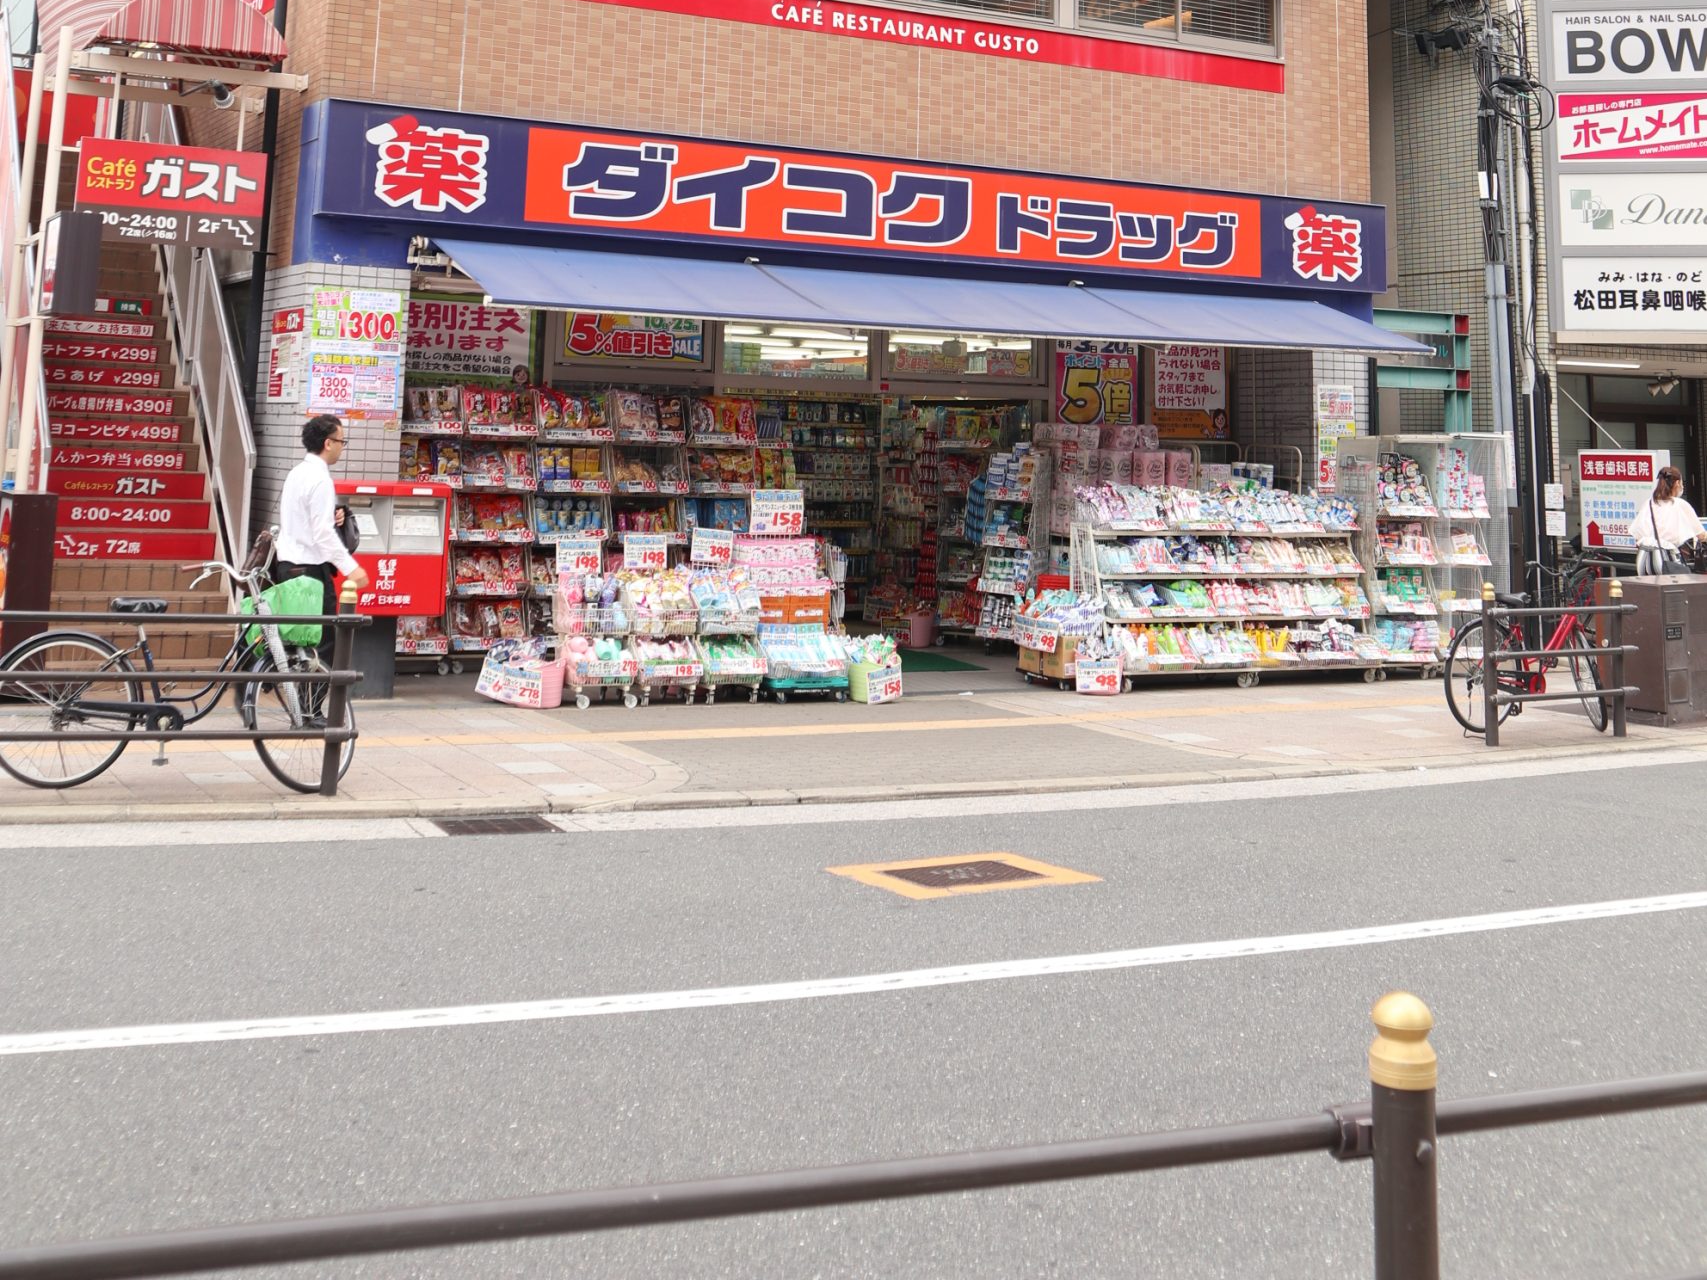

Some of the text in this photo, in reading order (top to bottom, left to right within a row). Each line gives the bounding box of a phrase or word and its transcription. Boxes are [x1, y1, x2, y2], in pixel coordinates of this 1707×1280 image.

[1565, 16, 1591, 25] HAIR
[1593, 15, 1631, 24] SALON
[1636, 15, 1644, 24] &
[1649, 14, 1674, 23] NAIL
[771, 0, 1040, 55] CAFÉ RESTAURANT GUSTO
[1571, 98, 1642, 115] お部屋探しの専門店
[1573, 104, 1707, 148] ホームメイト
[87, 157, 137, 178] Café
[368, 116, 489, 213] 薬
[86, 176, 135, 191] レストラン
[140, 157, 258, 204] ガスト
[562, 141, 1239, 269] ダイコク ドラッグ
[198, 219, 221, 234] 2F
[1284, 205, 1363, 282] 薬
[407, 331, 509, 352] 承ります
[674, 338, 701, 357] SALE
[1064, 354, 1130, 369] ポイント 全品
[1158, 359, 1221, 371] られない場合
[1158, 371, 1206, 382] スタッフまで
[1157, 384, 1218, 395] お気軽にお申し
[438, 421, 462, 430] 100
[514, 424, 537, 432] 100
[1583, 460, 1650, 477] 浅香歯科医院
[64, 480, 88, 490] Café
[114, 477, 167, 495] ガスト
[772, 512, 802, 526] 158
[76, 541, 99, 556] 2F
[709, 546, 731, 558] 398
[575, 556, 599, 568] 198
[642, 552, 665, 563] 198
[376, 579, 396, 590] POST
[378, 594, 411, 605] 日本郵便
[1040, 635, 1055, 647] 98
[622, 661, 638, 672] 278
[675, 665, 692, 676] 198
[1095, 675, 1118, 686] 98
[518, 687, 540, 699] 278
